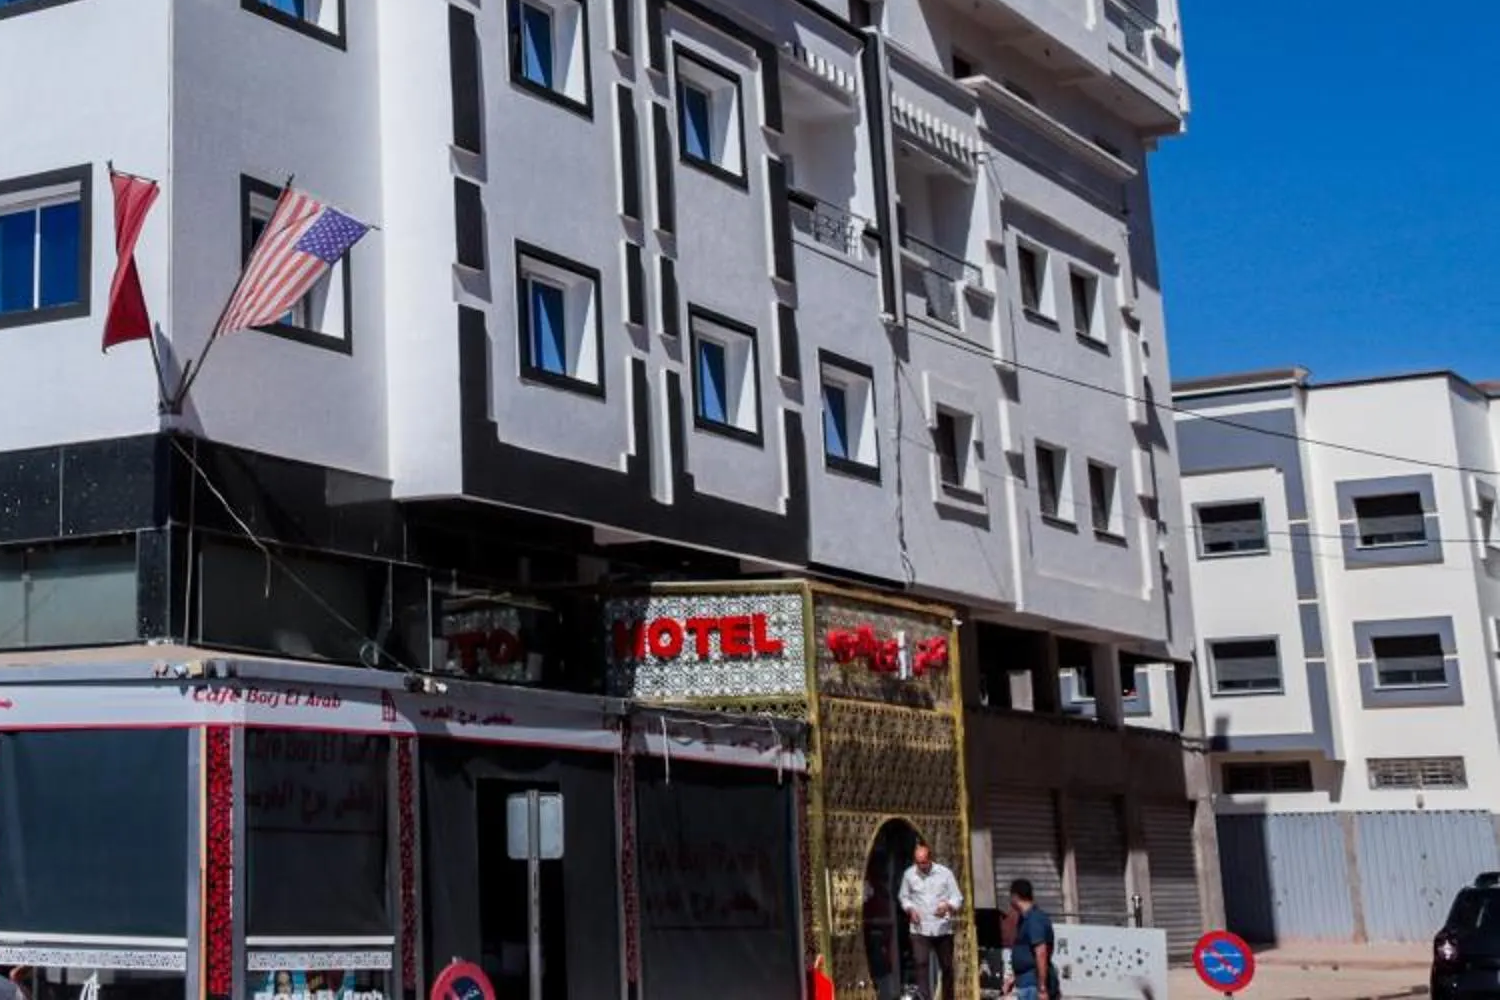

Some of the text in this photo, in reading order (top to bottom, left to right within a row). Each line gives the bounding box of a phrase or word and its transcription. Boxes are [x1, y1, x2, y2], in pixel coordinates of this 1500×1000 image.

[614, 613, 784, 661] HOTEL
[246, 687, 281, 709] Borj
[305, 689, 342, 709] Arab
